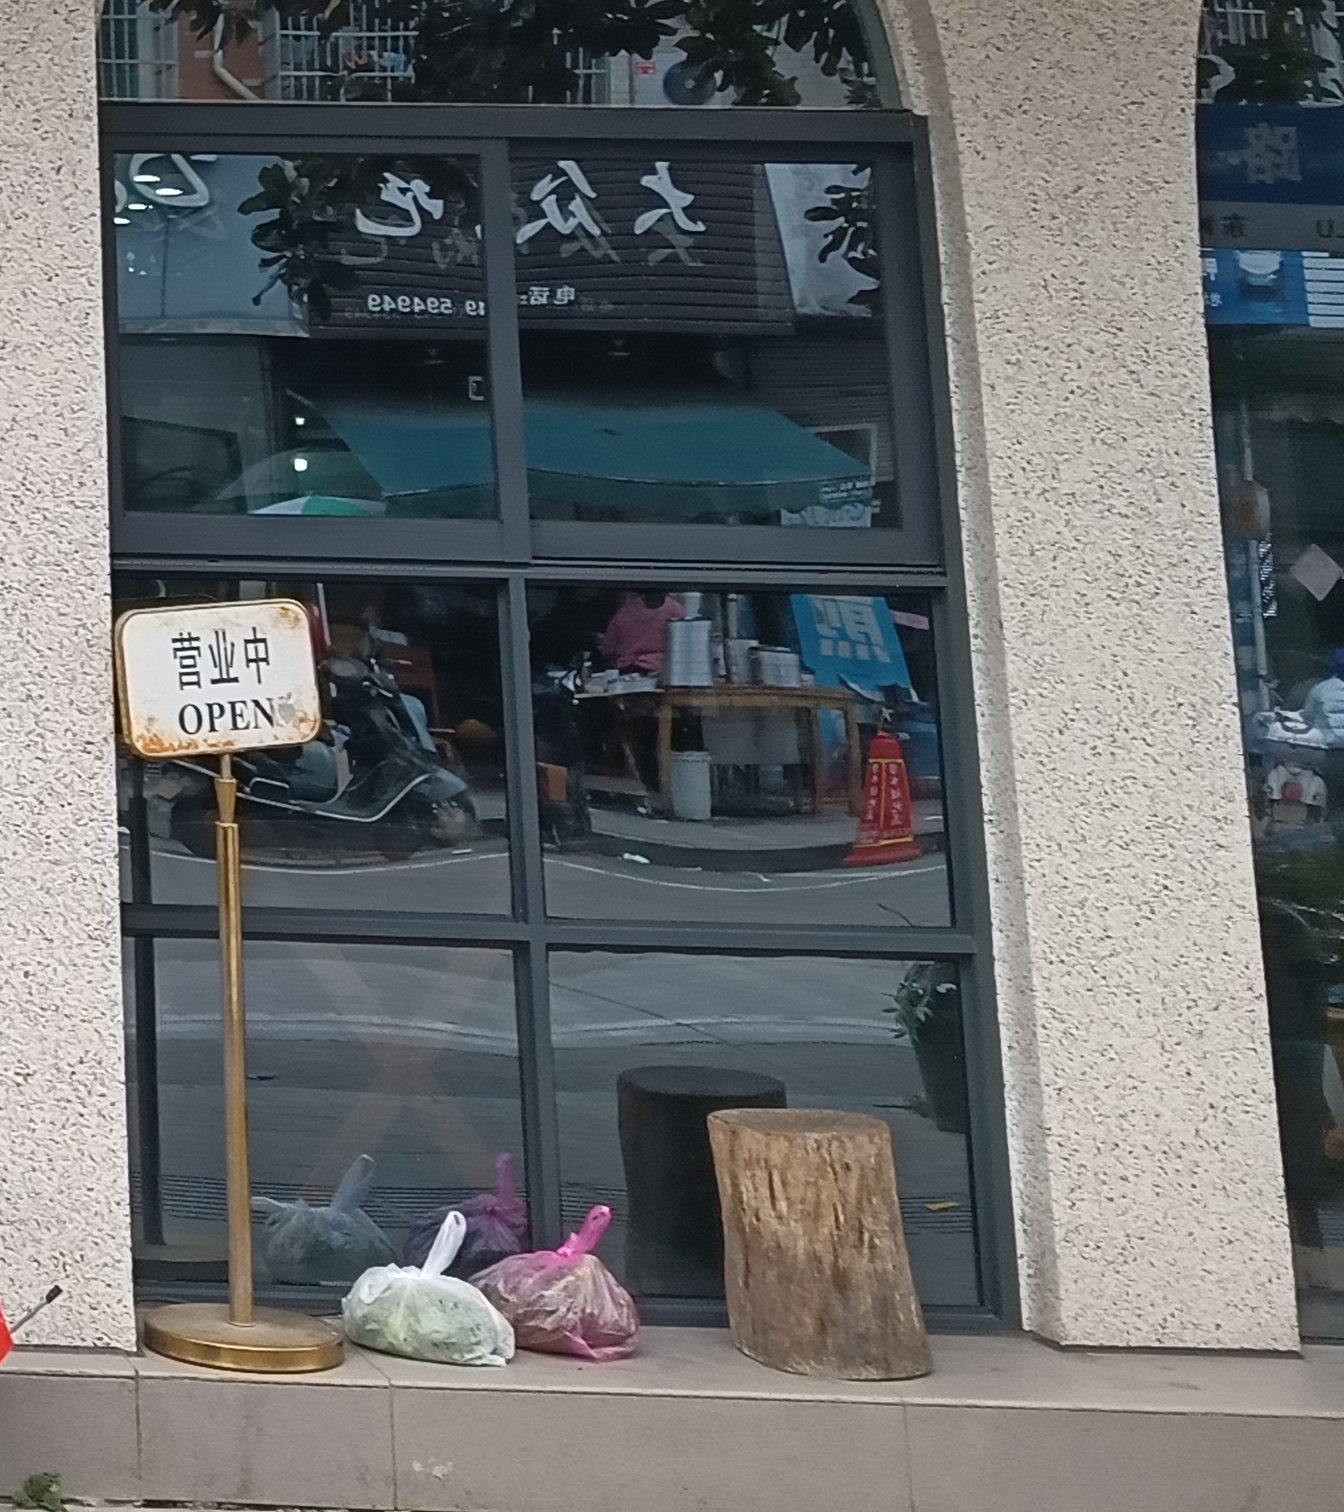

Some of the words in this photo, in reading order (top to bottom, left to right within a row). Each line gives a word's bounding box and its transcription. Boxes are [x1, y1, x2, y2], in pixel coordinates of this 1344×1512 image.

[171, 626, 271, 691] 营业中
[178, 696, 278, 735] OPEN
